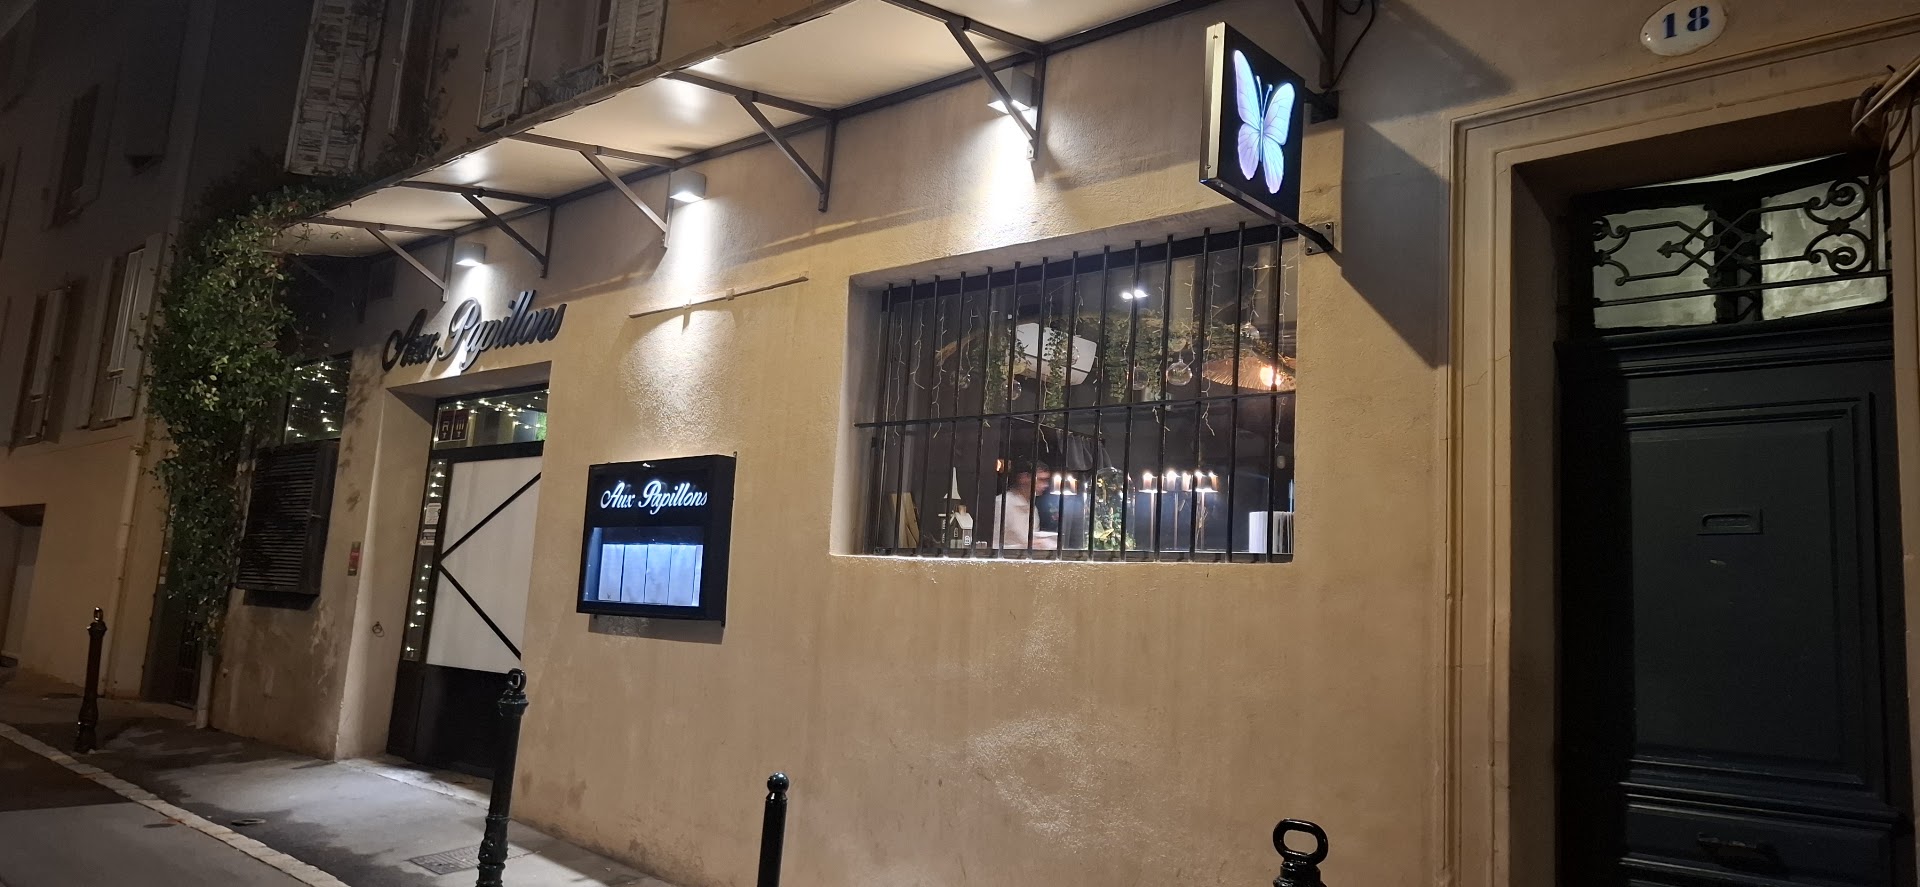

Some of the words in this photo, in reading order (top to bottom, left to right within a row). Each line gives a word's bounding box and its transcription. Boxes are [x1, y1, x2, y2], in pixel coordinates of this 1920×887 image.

[1662, 5, 1711, 39] 18
[382, 309, 441, 372] Aux
[437, 290, 567, 372] Papillons
[600, 481, 636, 509] Aux
[638, 480, 708, 515] Papillons
